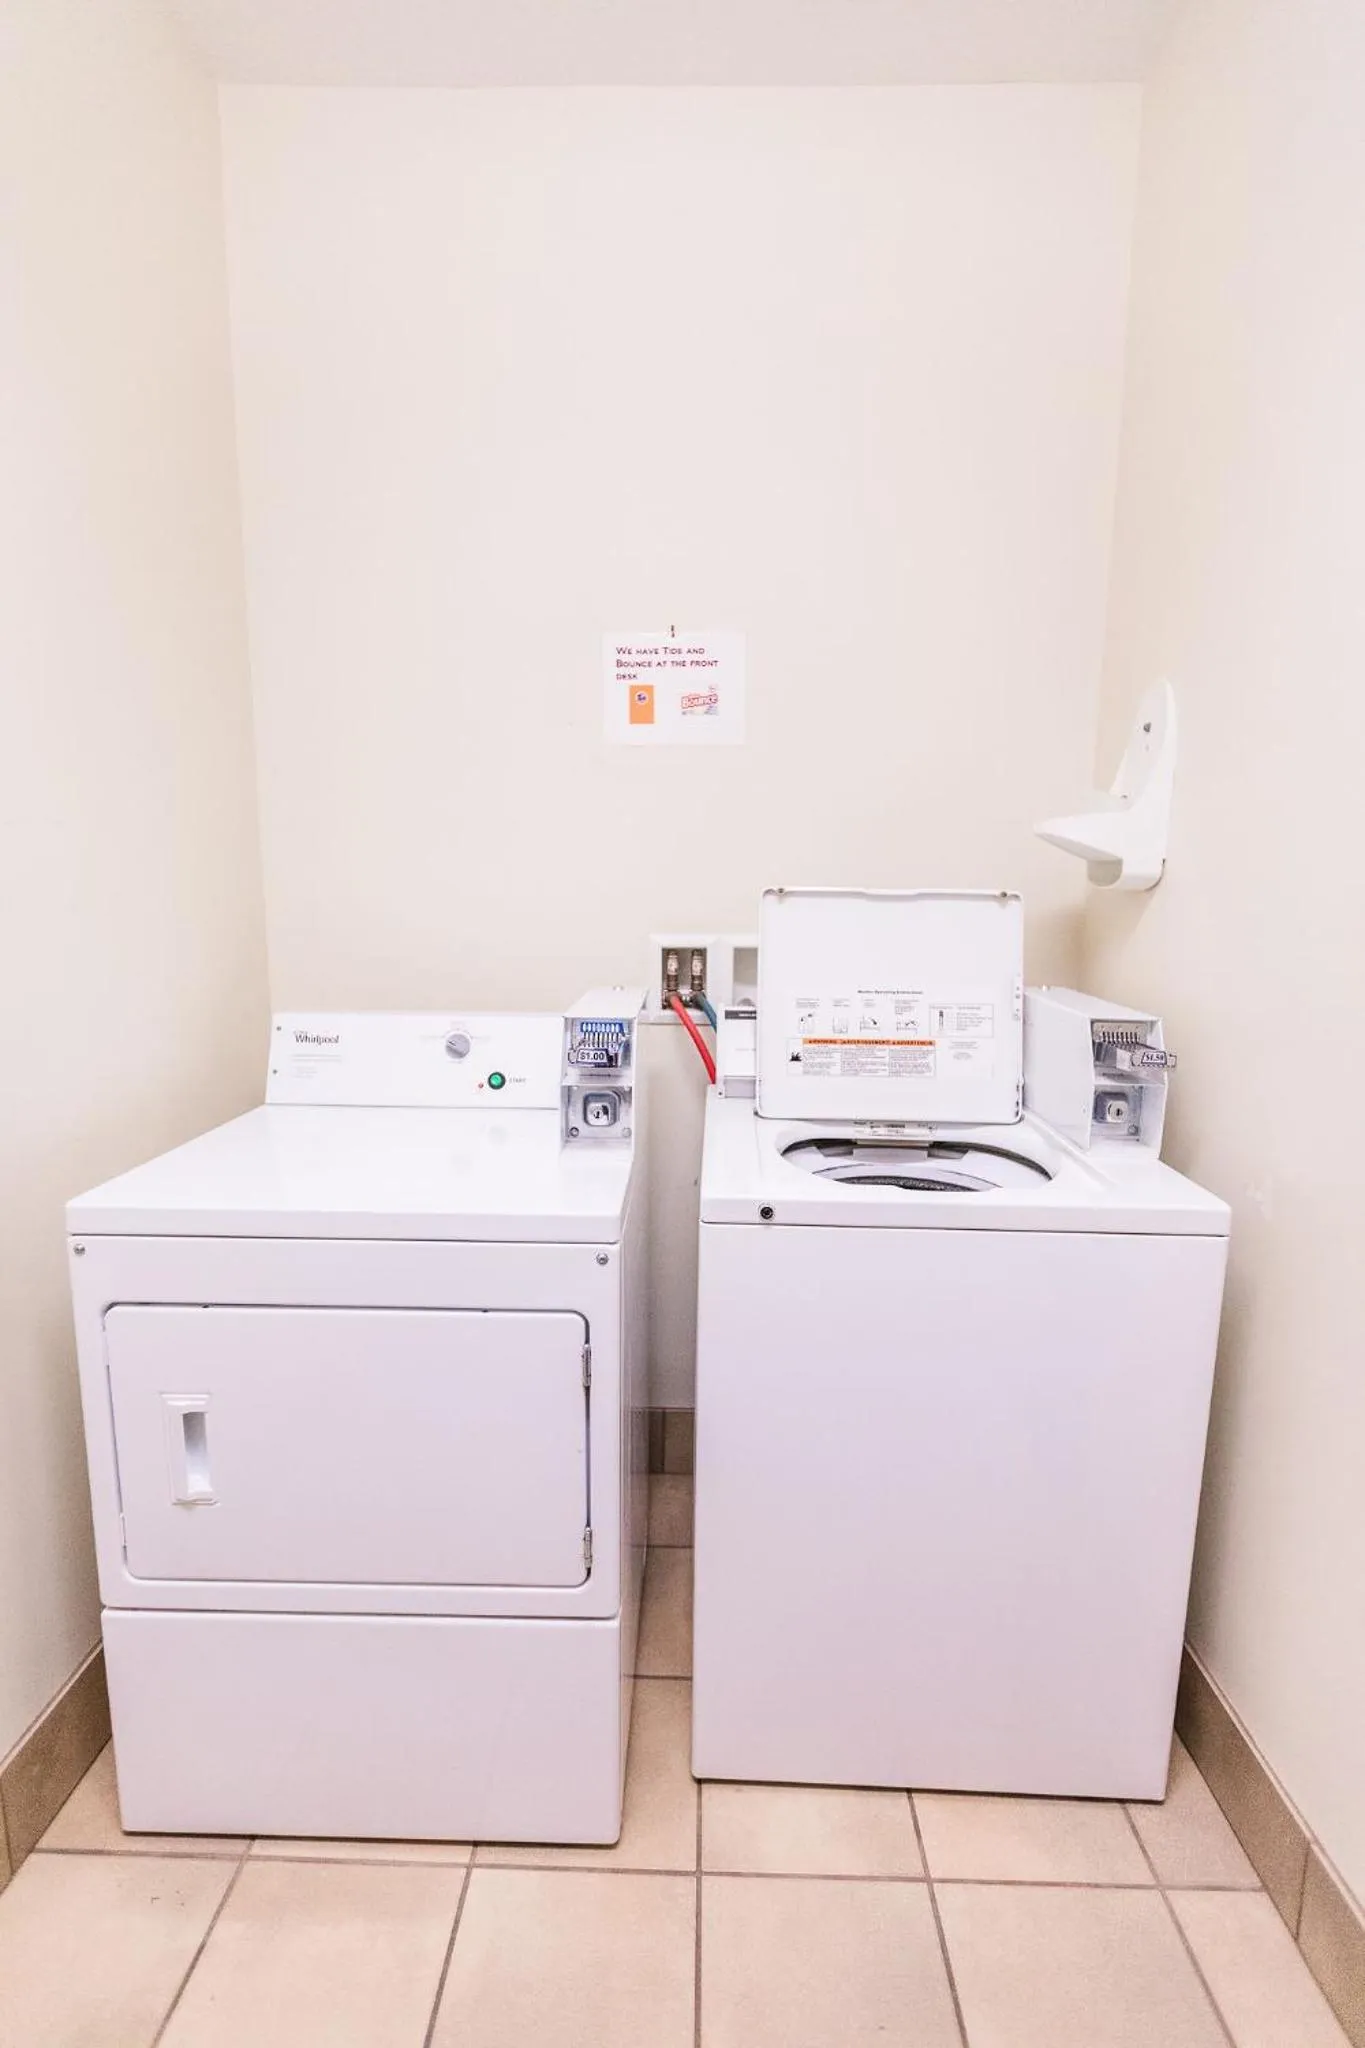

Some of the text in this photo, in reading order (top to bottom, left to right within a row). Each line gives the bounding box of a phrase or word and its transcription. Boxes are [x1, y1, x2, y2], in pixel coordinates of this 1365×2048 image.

[616, 659, 652, 668] BOUNCE
[295, 1032, 339, 1045] Whirlpool
[580, 1052, 605, 1061] $1.00
